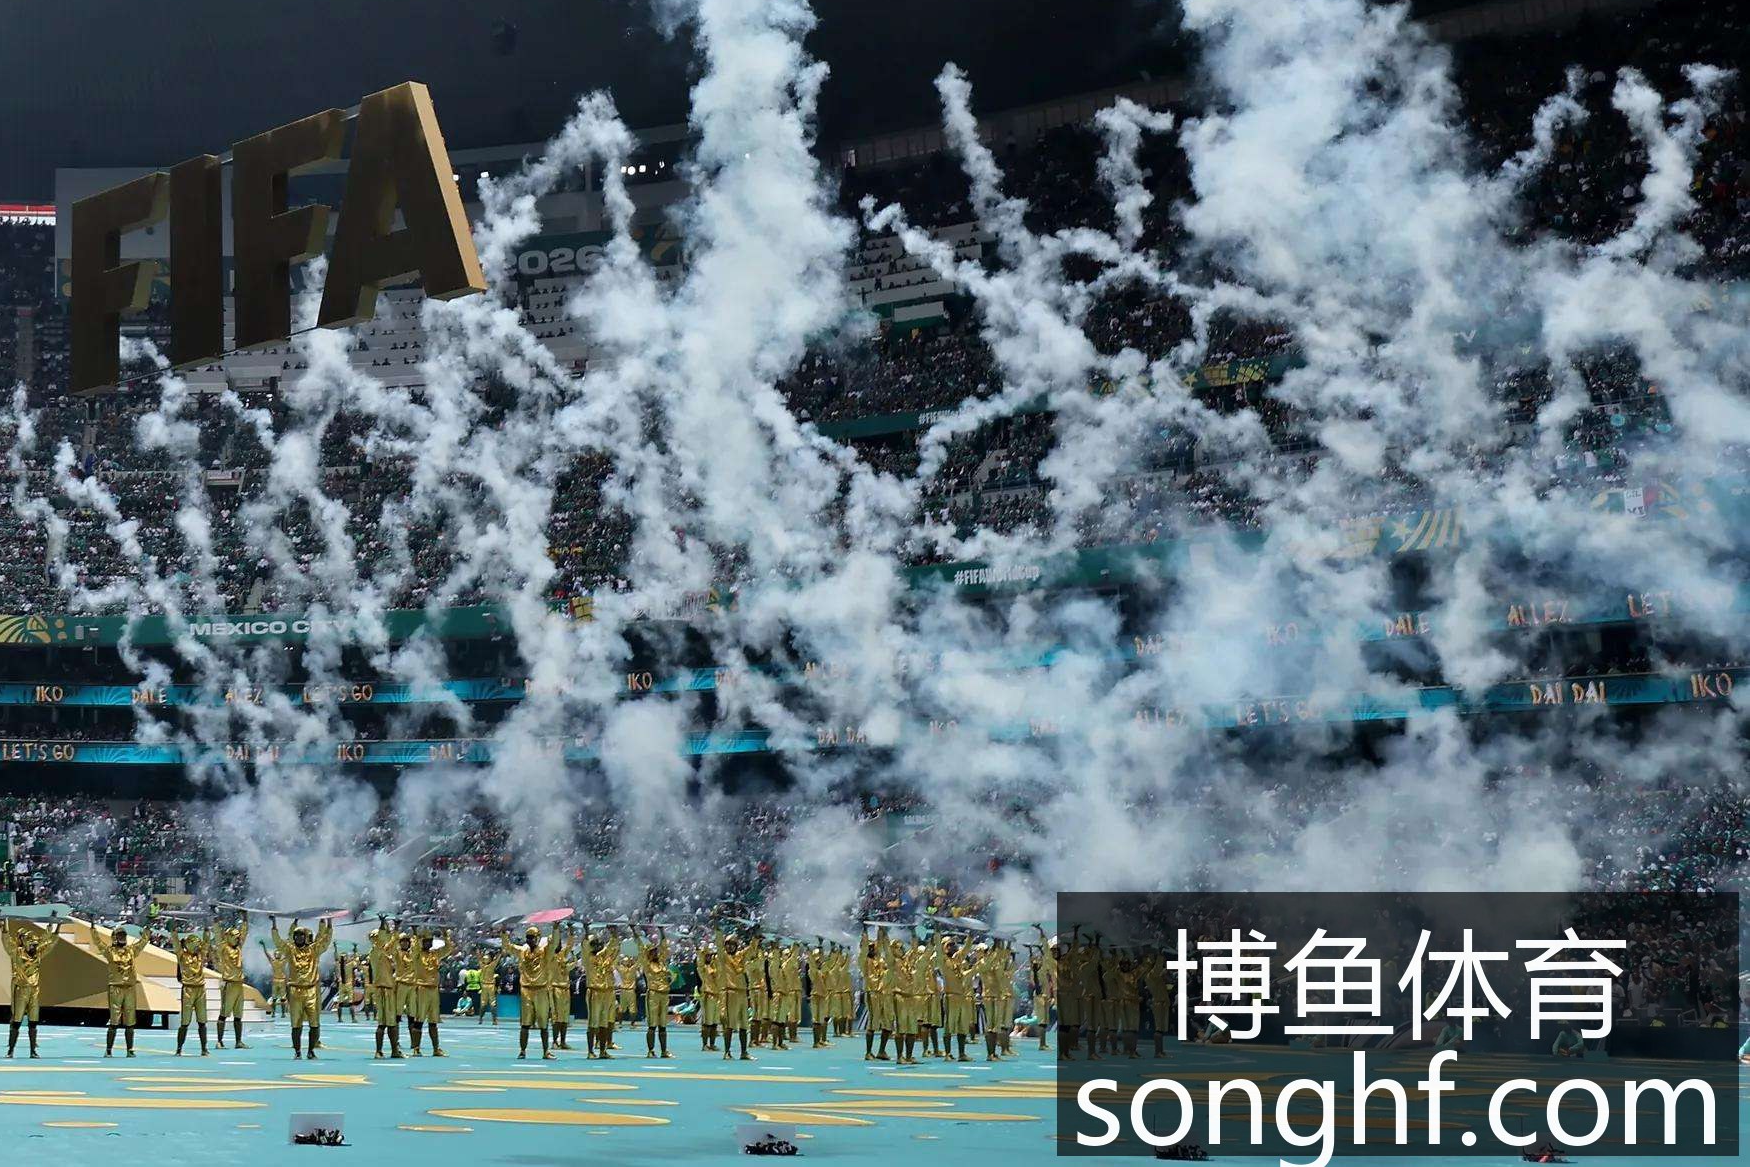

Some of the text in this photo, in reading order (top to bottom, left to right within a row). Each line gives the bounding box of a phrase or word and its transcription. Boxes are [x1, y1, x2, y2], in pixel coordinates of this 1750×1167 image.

[71, 80, 488, 396] FIFA
[35, 685, 64, 702] IKO
[131, 688, 167, 705] DALE
[352, 684, 373, 702] GO
[627, 672, 652, 690] IKO
[1507, 601, 1572, 626] ALLEZ
[189, 620, 288, 636] MEXICO
[2, 742, 48, 761] LET'S
[52, 744, 75, 761] GO
[225, 744, 249, 761] DAI
[337, 744, 363, 761] IKO
[1530, 680, 1563, 705] DAI
[1572, 679, 1606, 704] DAI
[1691, 672, 1732, 698] IKO
